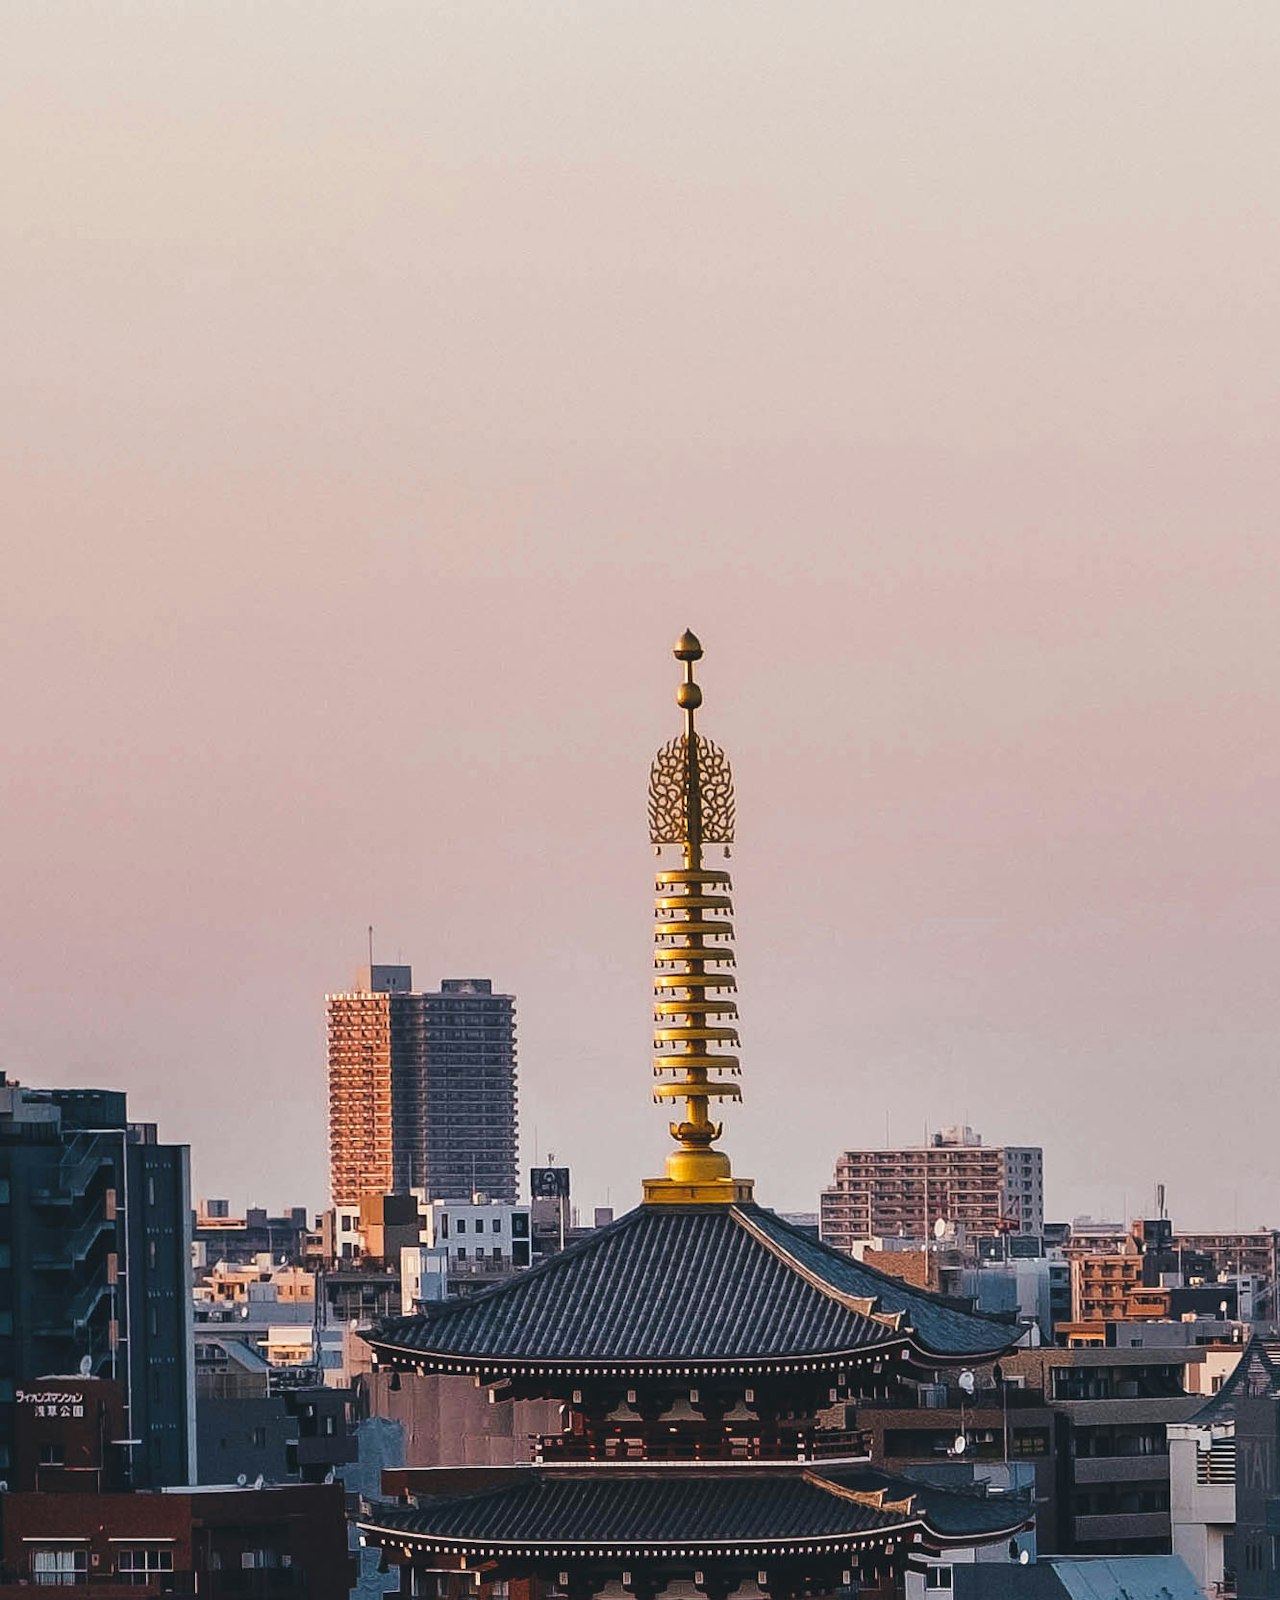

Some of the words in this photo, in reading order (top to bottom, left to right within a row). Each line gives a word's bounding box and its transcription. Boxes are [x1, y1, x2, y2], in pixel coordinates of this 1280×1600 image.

[16, 1390, 83, 1403] ライオンズマンション
[34, 1405, 84, 1417] 浅草公園
